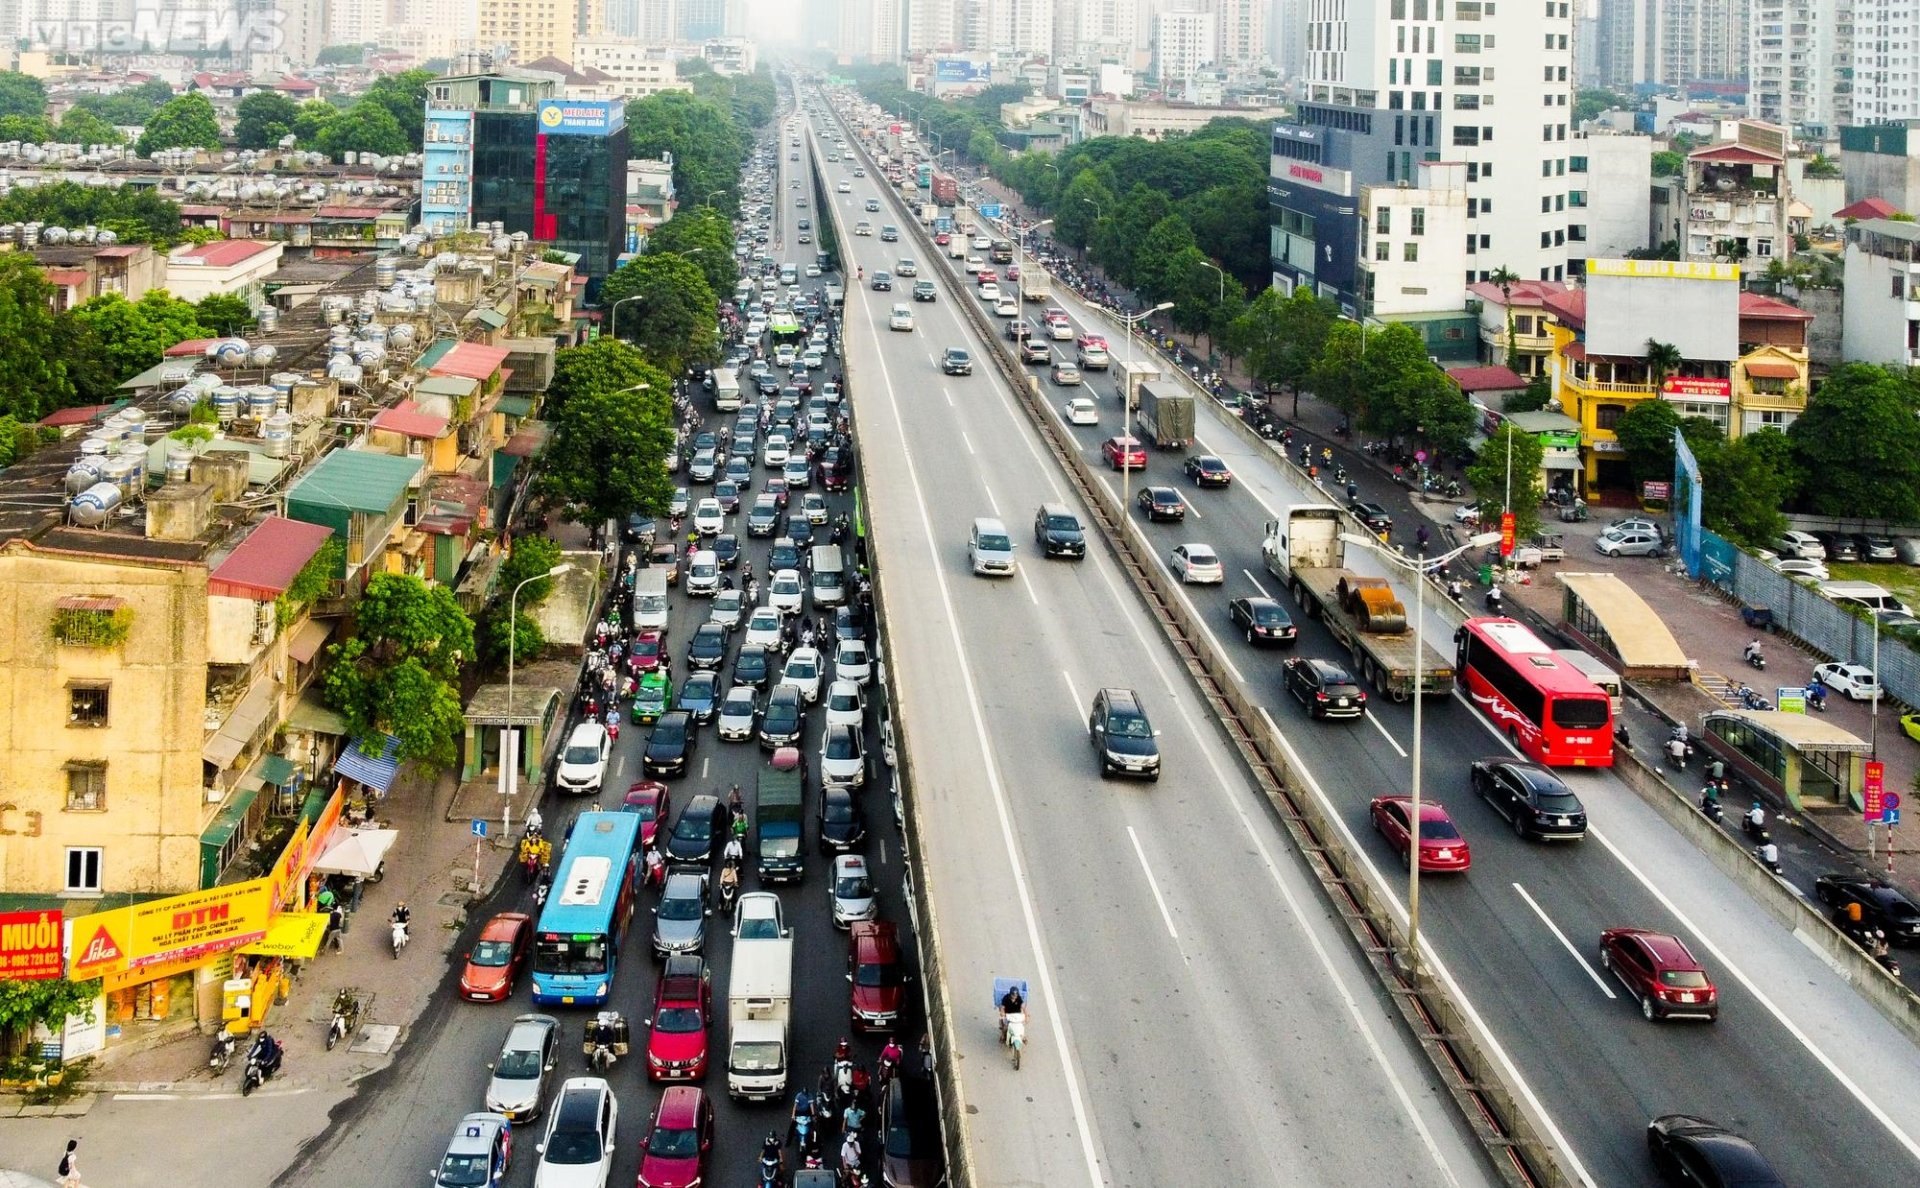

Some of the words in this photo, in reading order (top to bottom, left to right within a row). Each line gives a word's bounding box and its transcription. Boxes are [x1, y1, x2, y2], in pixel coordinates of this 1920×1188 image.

[563, 108, 605, 118] MEDLATEC
[172, 902, 230, 930] DTH
[2, 912, 58, 952] MUỖI
[82, 937, 117, 964] Sika
[263, 942, 296, 950] weber
